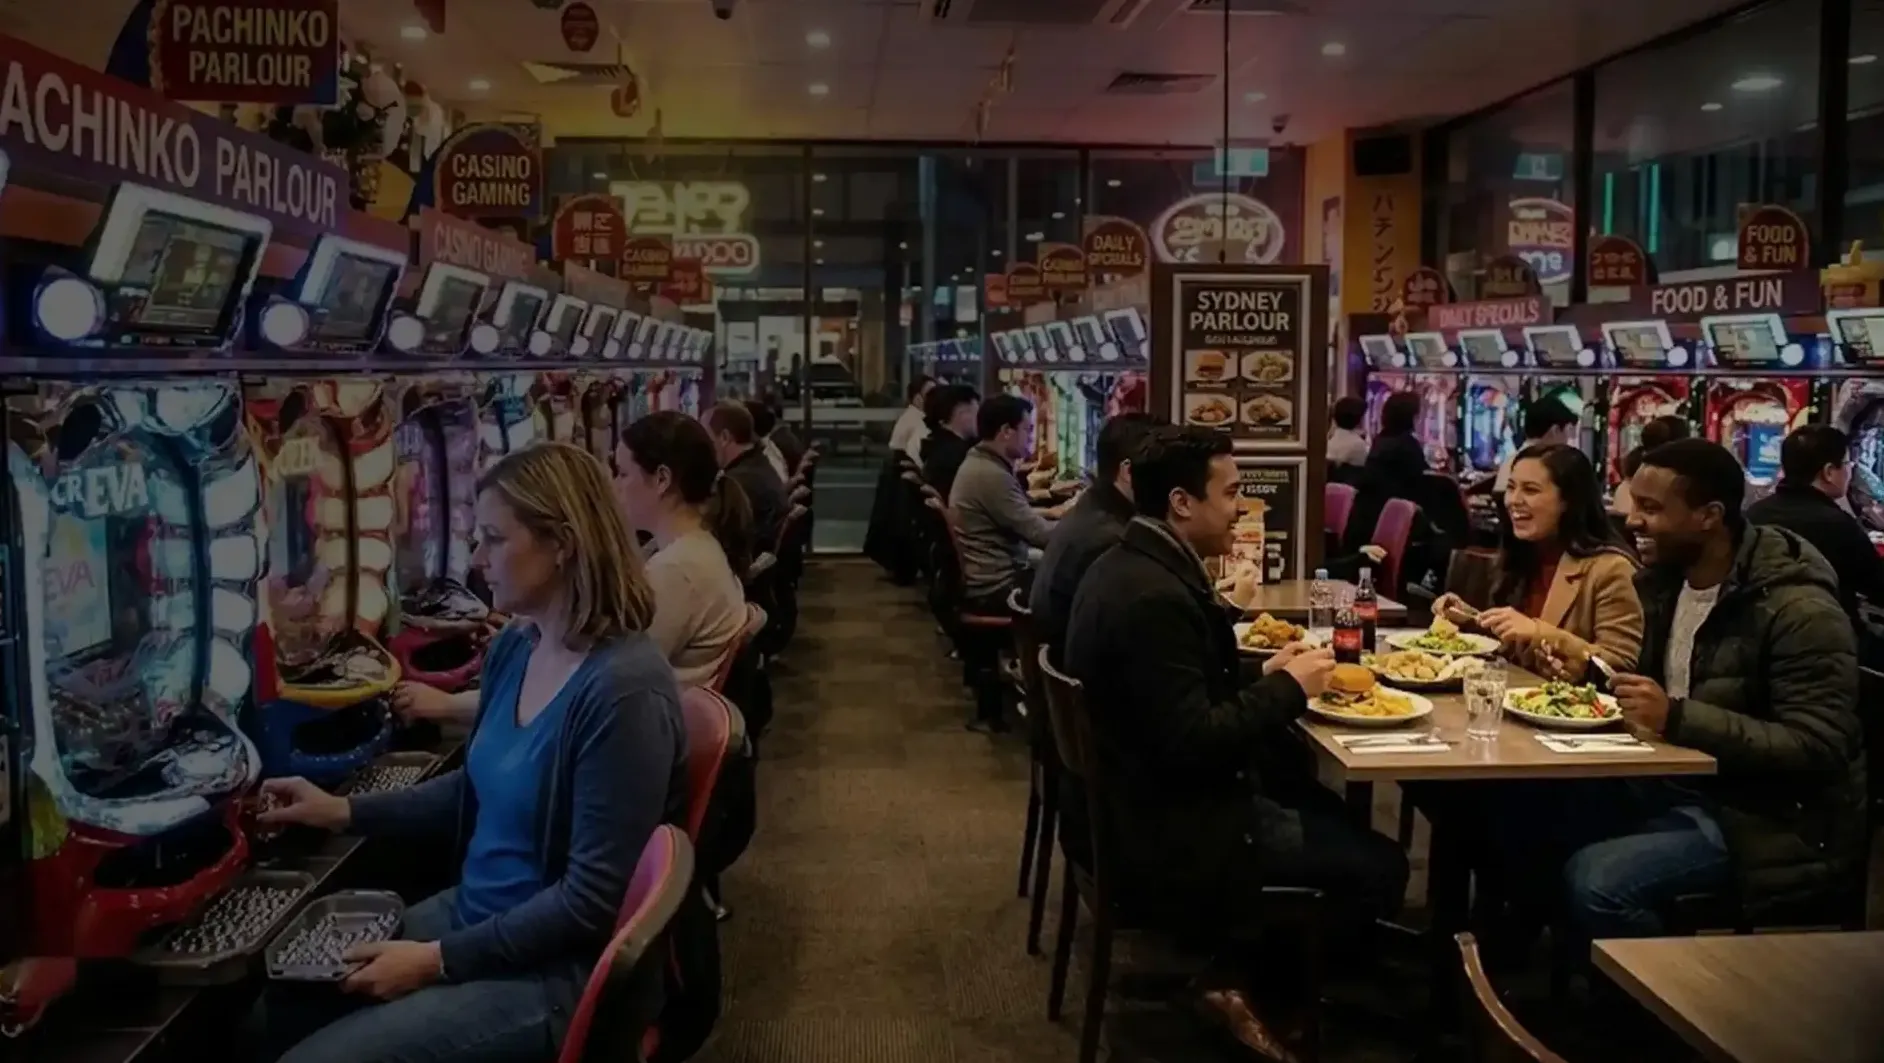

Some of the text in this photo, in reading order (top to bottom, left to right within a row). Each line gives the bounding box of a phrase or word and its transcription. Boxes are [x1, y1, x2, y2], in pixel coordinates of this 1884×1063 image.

[172, 4, 330, 48] PACHINKO
[188, 51, 312, 88] PARLOUR
[0, 60, 338, 228] ACHINKO PARLOUR
[452, 153, 531, 180] CASINO
[452, 180, 531, 206] GAMING
[1747, 224, 1796, 244] FOOD
[1744, 246, 1797, 264] & FUN
[1197, 290, 1284, 311] SYDNEY
[1651, 279, 1783, 315] FOOD & FUN
[1189, 311, 1291, 332] PARLOUR
[83, 462, 149, 516] EVA
